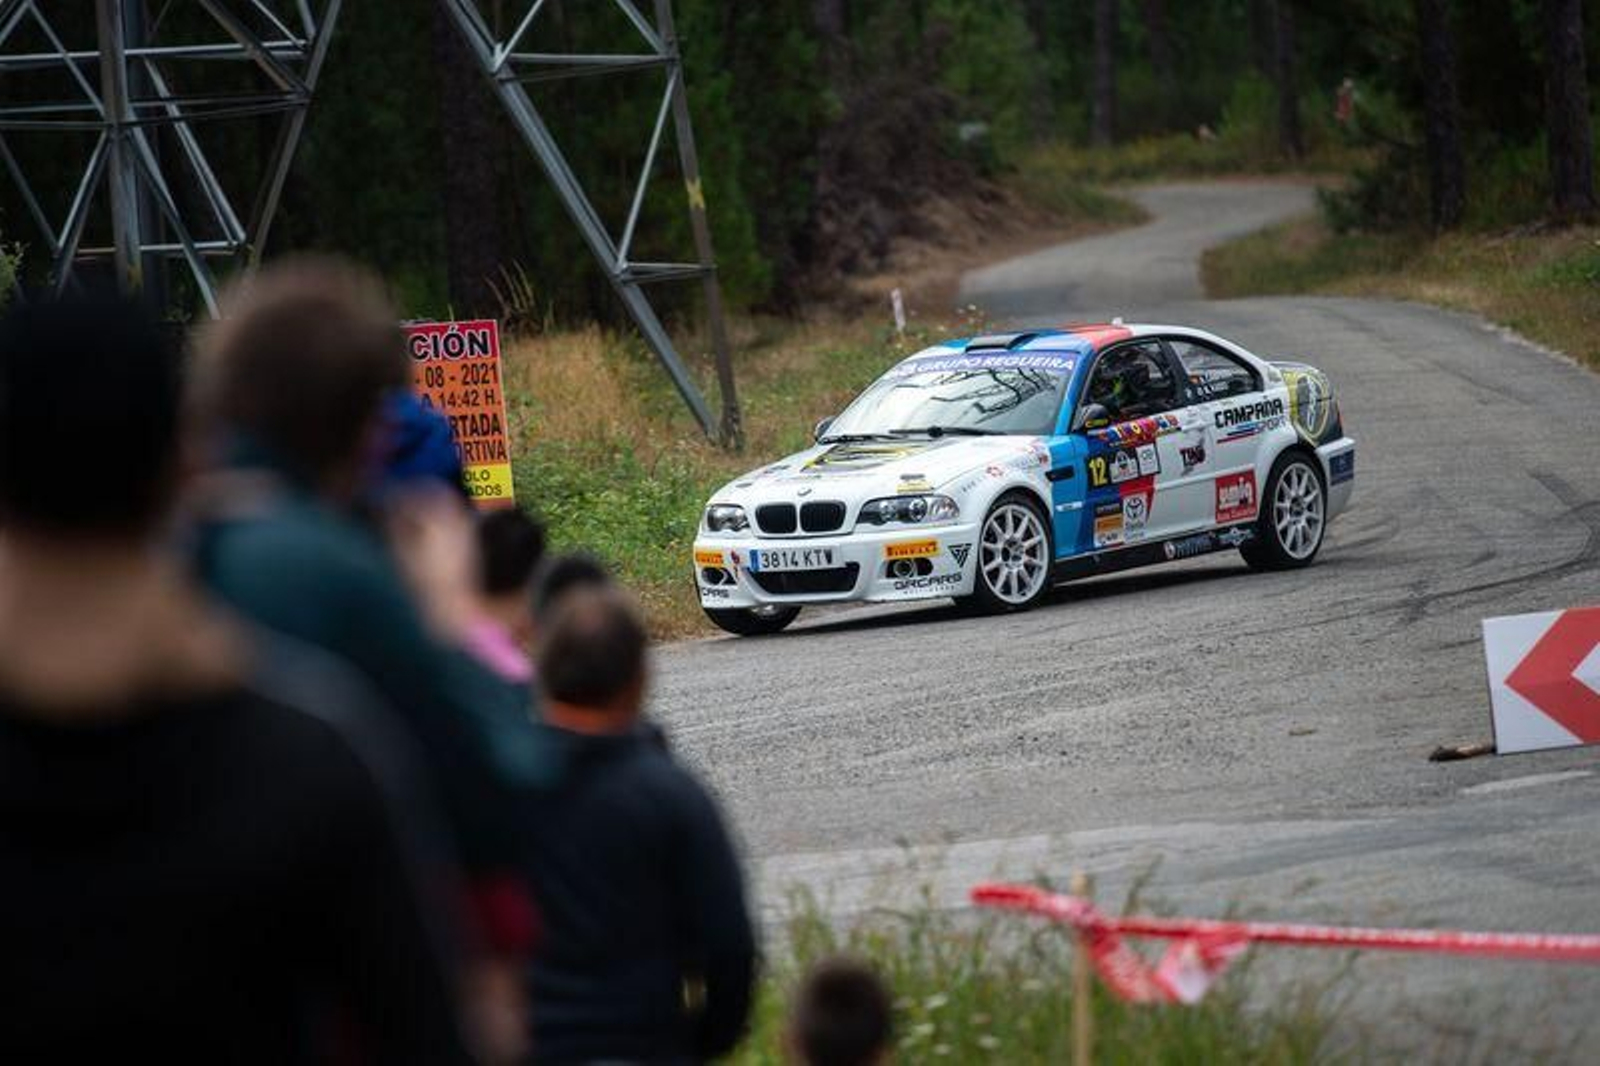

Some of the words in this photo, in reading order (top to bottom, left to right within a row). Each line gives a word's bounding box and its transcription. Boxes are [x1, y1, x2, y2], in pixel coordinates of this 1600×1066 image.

[409, 325, 490, 361] CIÓN
[425, 365, 445, 388] 08
[461, 362, 499, 386] 2021
[917, 358, 983, 373] GRUPO
[982, 355, 1076, 371] REGUEIRA
[438, 391, 480, 409] 14:42
[1088, 457, 1108, 487] 12
[761, 551, 798, 569] 3814
